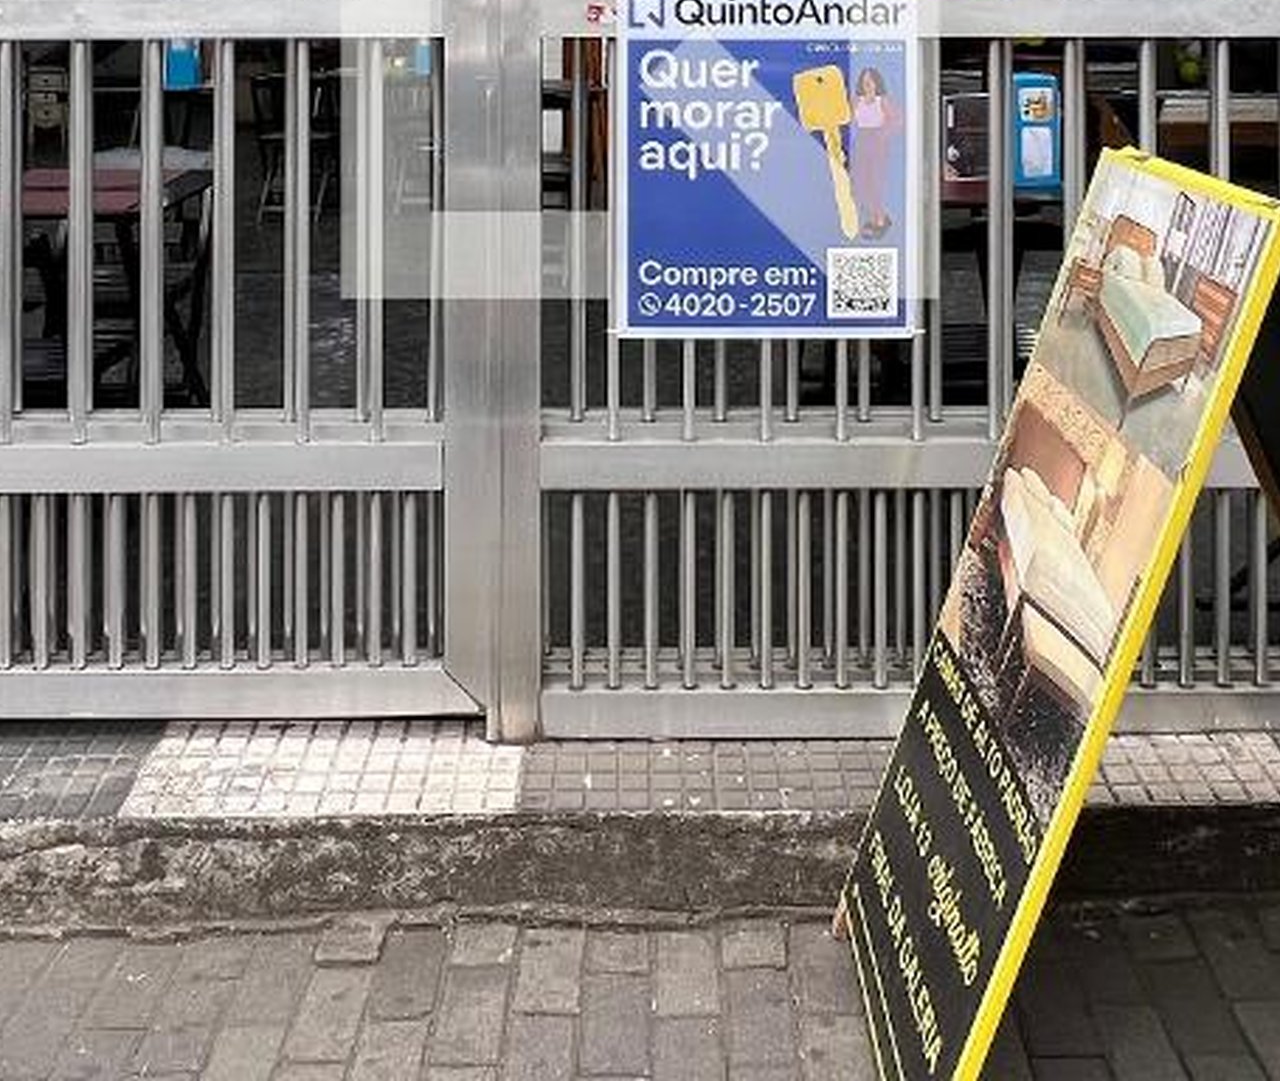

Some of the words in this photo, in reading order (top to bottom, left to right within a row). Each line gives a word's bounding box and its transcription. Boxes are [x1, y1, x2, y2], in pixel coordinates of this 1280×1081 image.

[639, 49, 760, 89] Quer
[639, 98, 784, 130] morar
[639, 131, 770, 180] aqui?
[638, 260, 758, 290] Compre
[764, 264, 818, 287] em:
